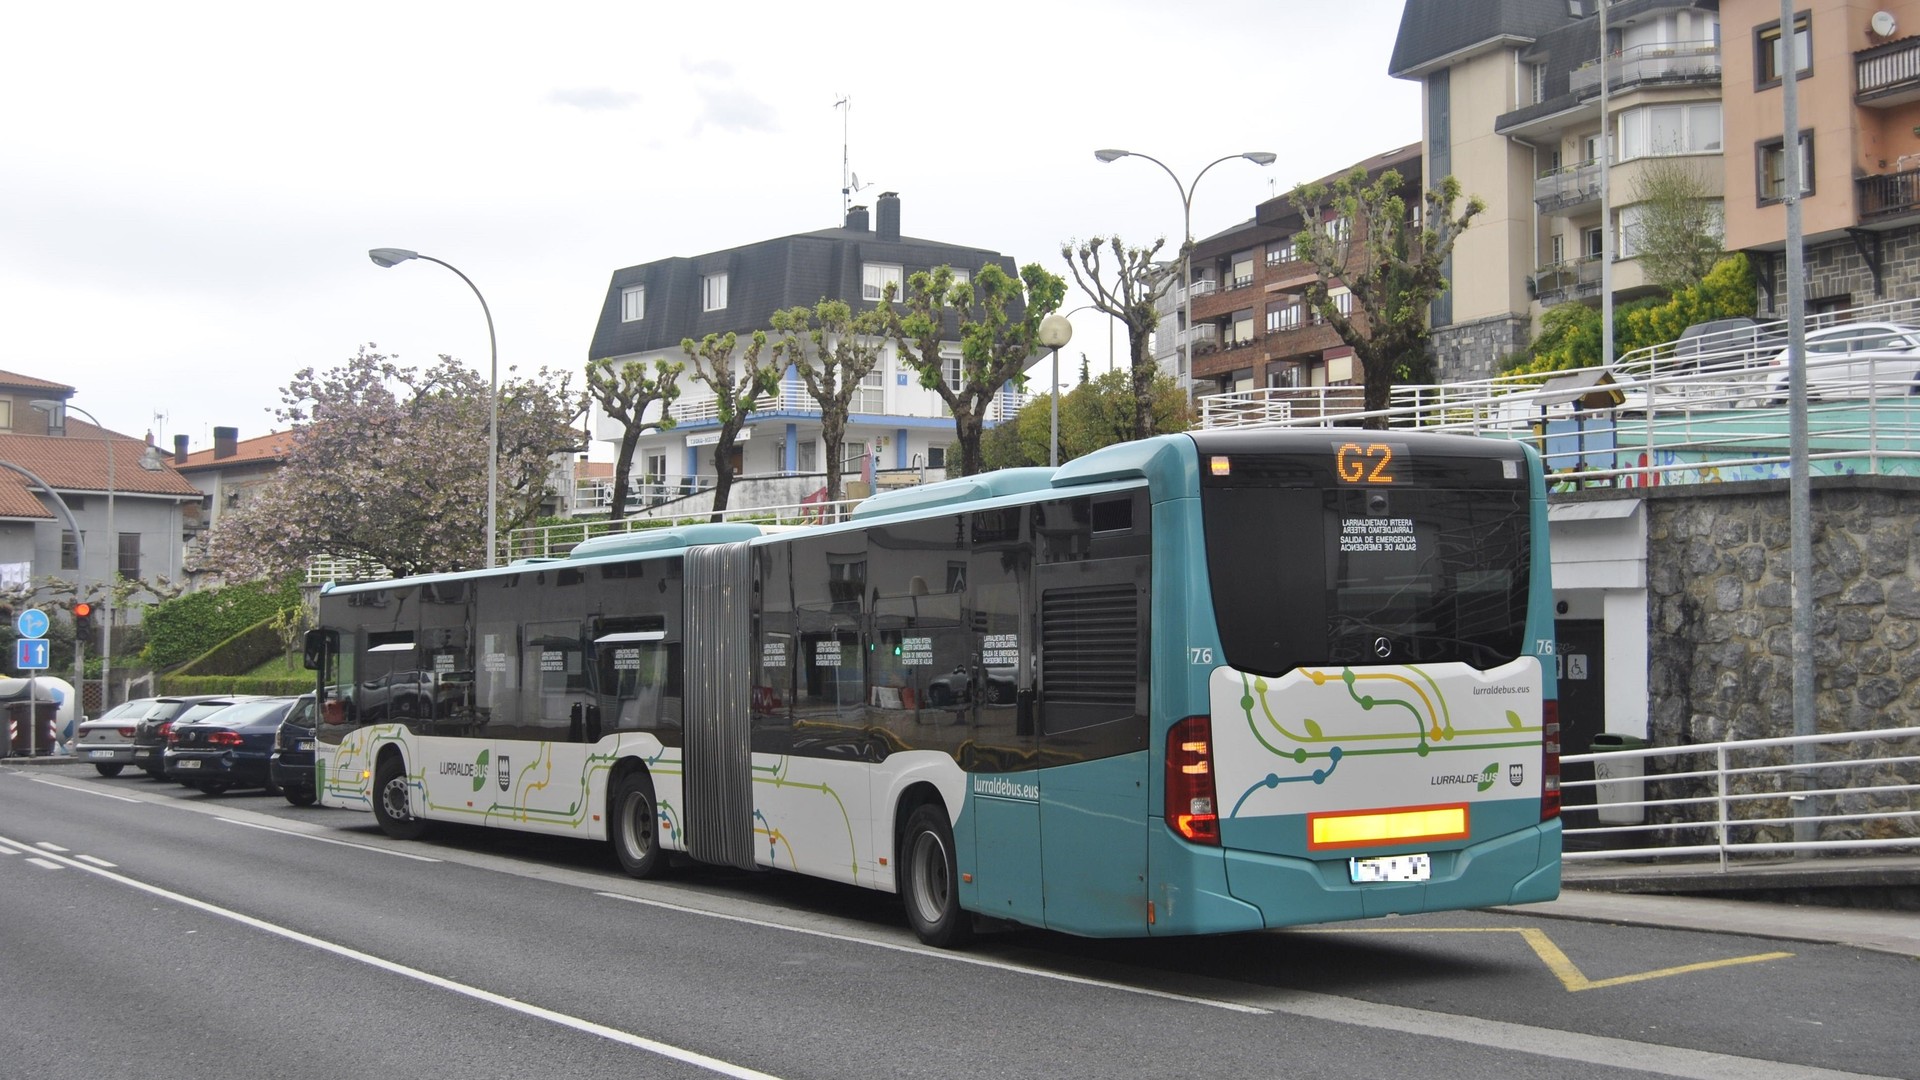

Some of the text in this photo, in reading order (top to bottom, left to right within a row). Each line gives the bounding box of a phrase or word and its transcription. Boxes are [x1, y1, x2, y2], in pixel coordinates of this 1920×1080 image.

[1337, 443, 1392, 482] G2
[1342, 519, 1388, 527] LARRIALDIETAKO
[1538, 640, 1553, 654] 76
[1191, 648, 1212, 664] 76
[1473, 685, 1530, 695] lurraldebus.eus
[1431, 772, 1498, 785] LURRALDEBUS
[974, 775, 1039, 798] lurraldebus.eus
